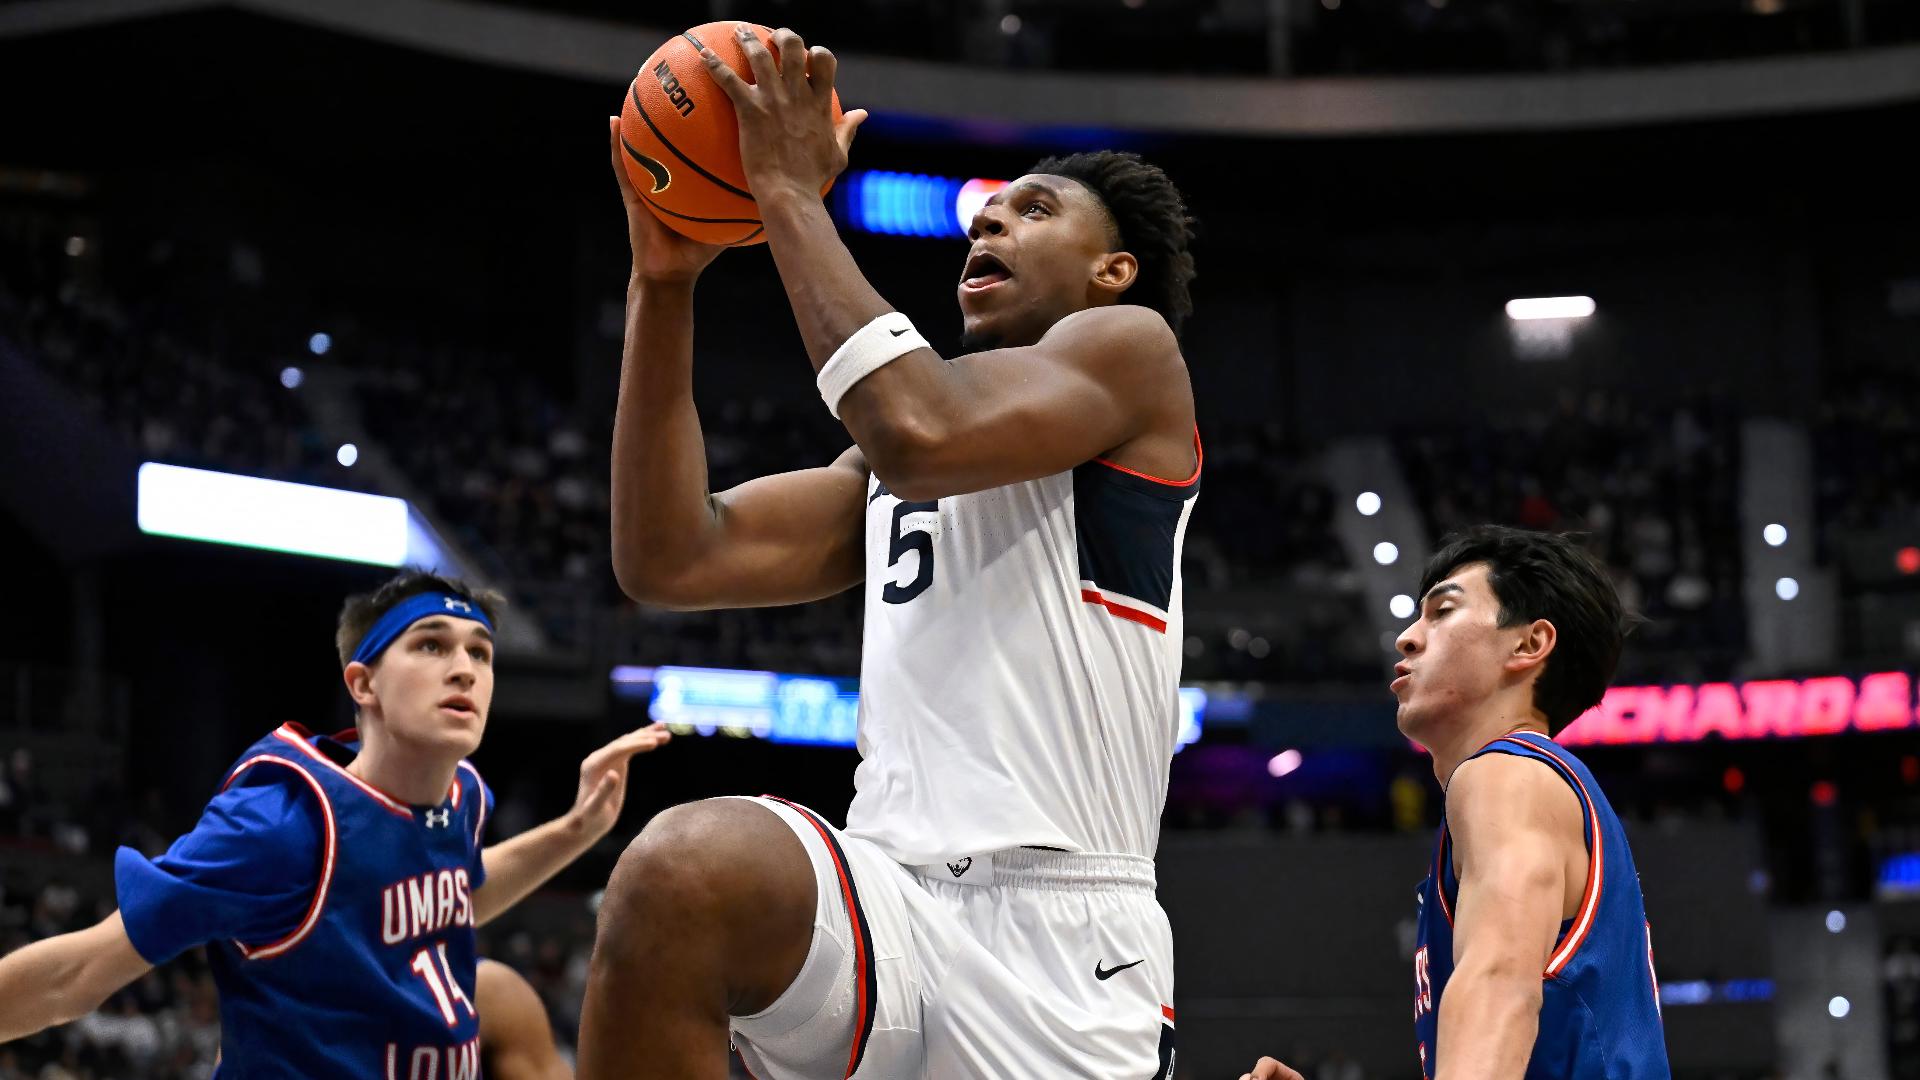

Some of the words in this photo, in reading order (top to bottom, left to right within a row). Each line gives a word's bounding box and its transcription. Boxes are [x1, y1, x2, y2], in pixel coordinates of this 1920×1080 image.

[653, 60, 695, 117] UCONN
[882, 500, 939, 604] 5
[382, 867, 475, 944] UMAS
[410, 943, 476, 1026] 14
